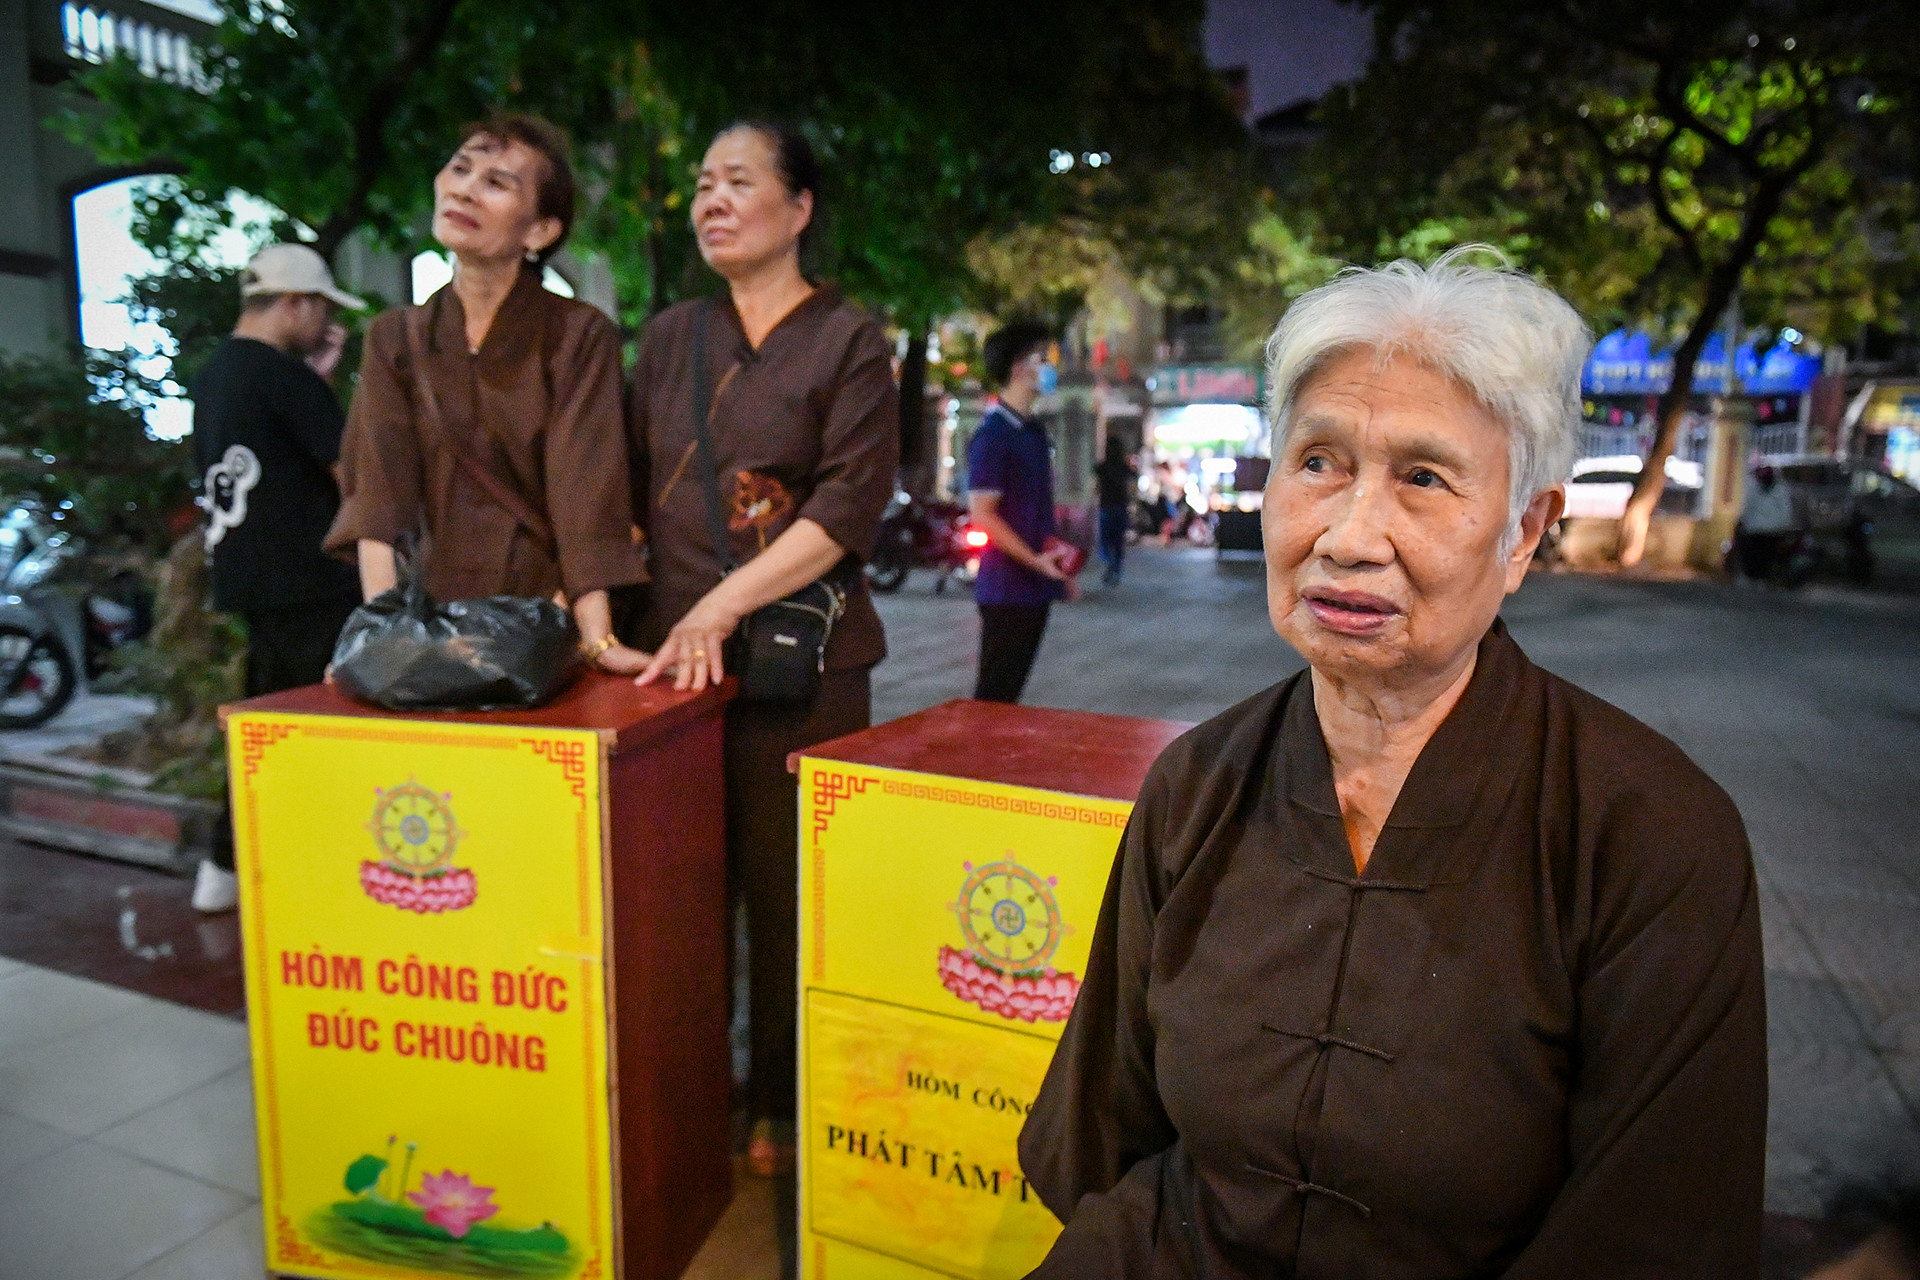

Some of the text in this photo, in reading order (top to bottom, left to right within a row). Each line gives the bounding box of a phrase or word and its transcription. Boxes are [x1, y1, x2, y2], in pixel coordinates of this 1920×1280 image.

[281, 944, 567, 1013] HÒM CÔNG ĐỨC
[308, 1008, 546, 1072] ĐÚC CHUÔNG
[906, 1069, 959, 1100] HÒM
[827, 1124, 916, 1168] PHÁT
[923, 1150, 1000, 1195] TÂM
